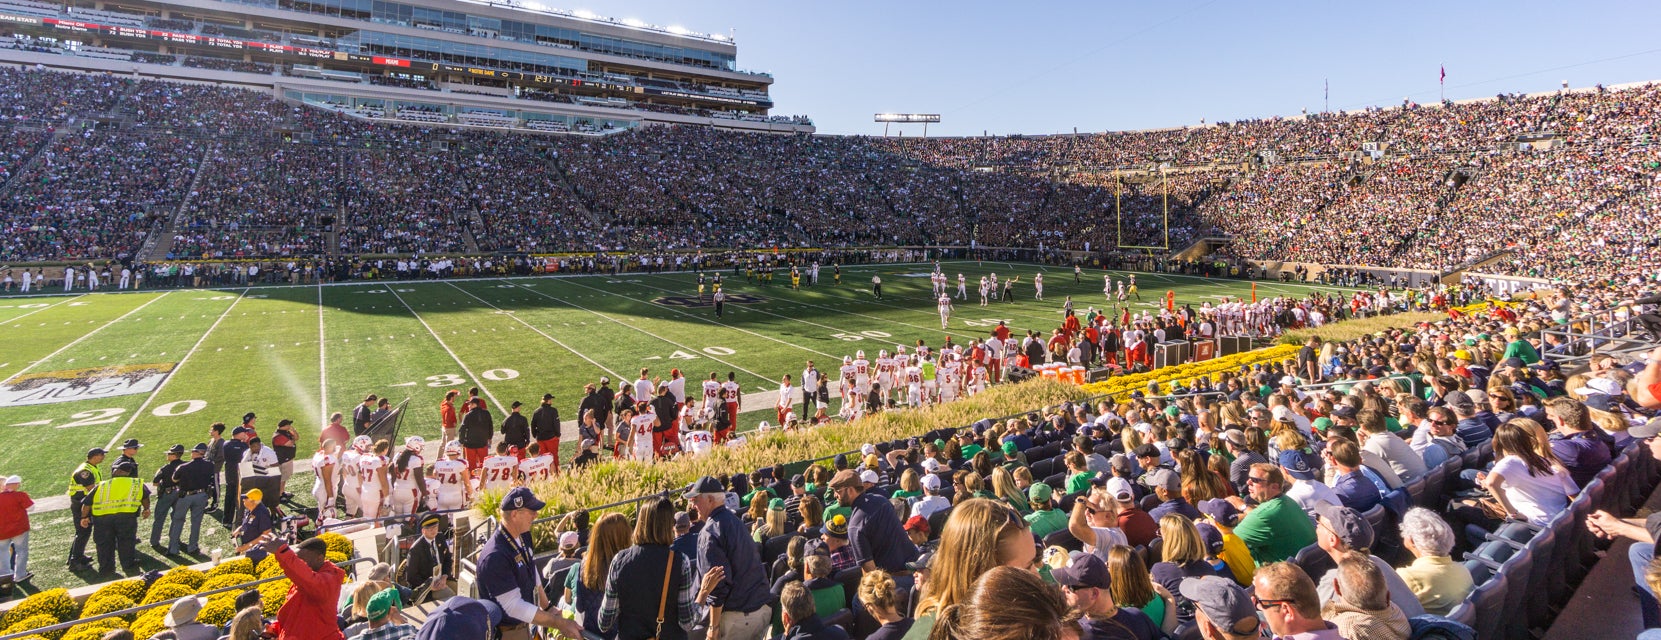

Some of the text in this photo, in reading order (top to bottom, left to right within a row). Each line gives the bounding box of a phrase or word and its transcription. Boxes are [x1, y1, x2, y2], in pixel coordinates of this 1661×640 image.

[17, 16, 37, 24] STATS
[432, 63, 438, 71] 0
[829, 330, 892, 342] 50
[668, 346, 736, 360] 40
[857, 365, 866, 374] 19
[426, 368, 520, 388] 30
[705, 388, 716, 398] 45
[55, 400, 208, 429] 20
[638, 422, 653, 436] 44
[439, 473, 457, 485] 74
[490, 467, 511, 482] 78
